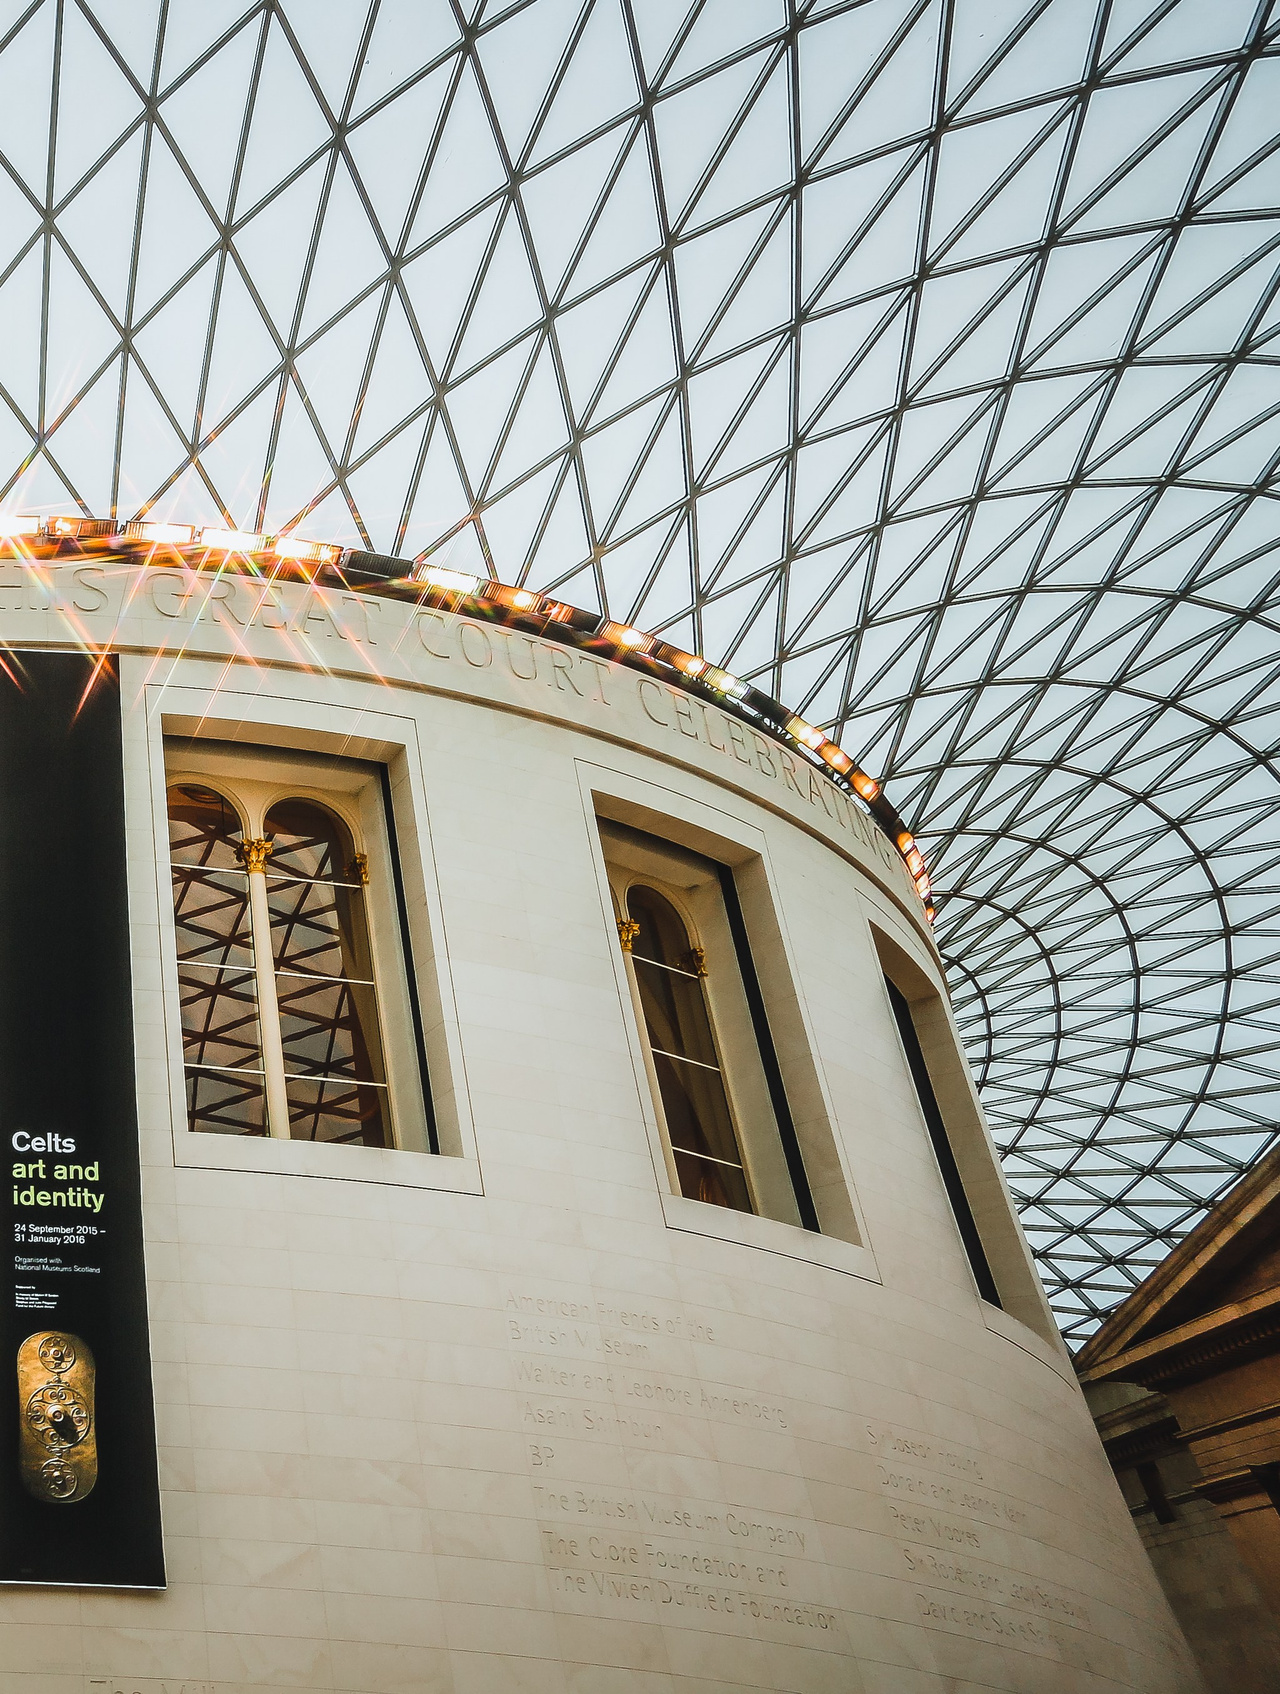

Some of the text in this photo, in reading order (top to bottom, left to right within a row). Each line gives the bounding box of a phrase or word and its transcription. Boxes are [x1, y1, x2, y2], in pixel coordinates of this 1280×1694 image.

[145, 571, 381, 646] GREAT
[416, 610, 612, 707] COURT
[636, 678, 892, 872] CELEBRATING
[11, 1130, 76, 1154] Celts
[12, 1159, 100, 1181] art and
[13, 1185, 105, 1213] identity
[14, 1224, 26, 1232] 24
[28, 1224, 75, 1235] September
[76, 1225, 98, 1235] 2015
[14, 1233, 85, 1245] 31 January 2016
[15, 1255, 47, 1265] Organised
[15, 1263, 100, 1274] National Museums Scotland
[506, 1289, 589, 1317] American
[726, 1513, 806, 1552] Company
[542, 1530, 579, 1557] The
[644, 1543, 747, 1579] Foundation
[757, 1565, 789, 1588] and
[549, 1567, 586, 1594] The
[738, 1591, 839, 1631] Foundation
